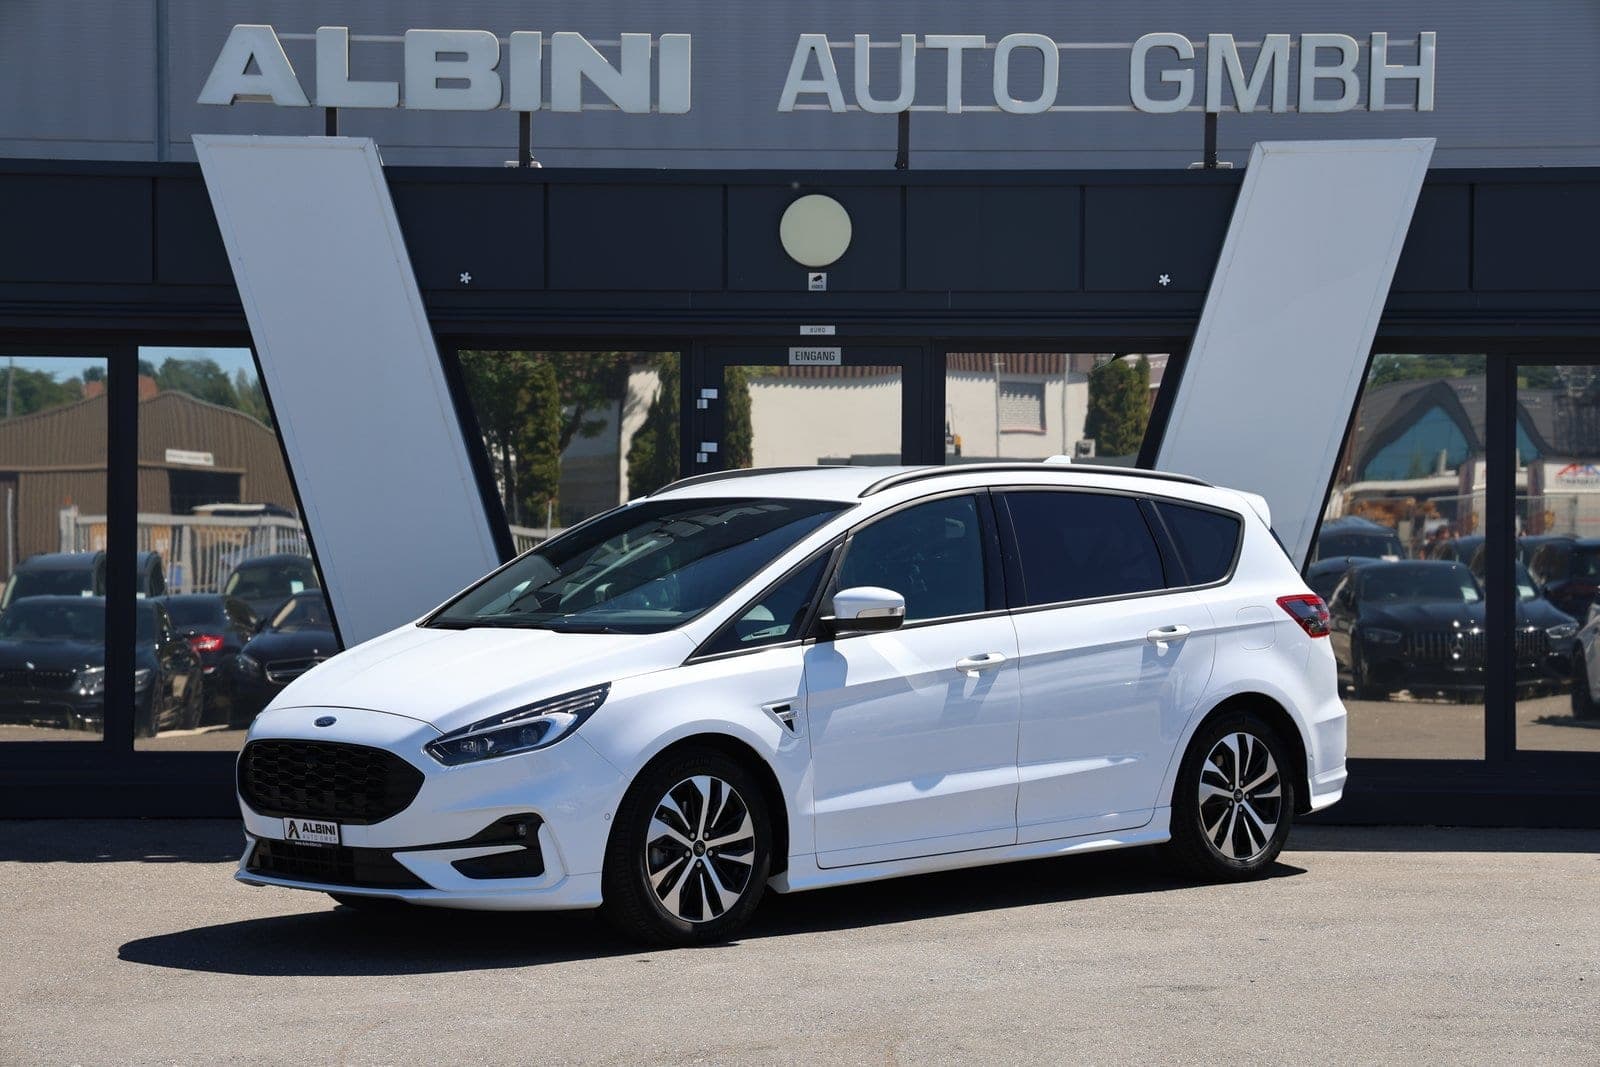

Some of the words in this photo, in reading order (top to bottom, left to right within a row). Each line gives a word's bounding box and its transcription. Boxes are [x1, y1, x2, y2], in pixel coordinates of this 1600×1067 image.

[197, 24, 692, 114] ALBINI
[778, 33, 1058, 115] AUTO
[1130, 31, 1437, 114] GMBH
[795, 351, 835, 361] EINGANG
[302, 822, 336, 835] ALBINI
